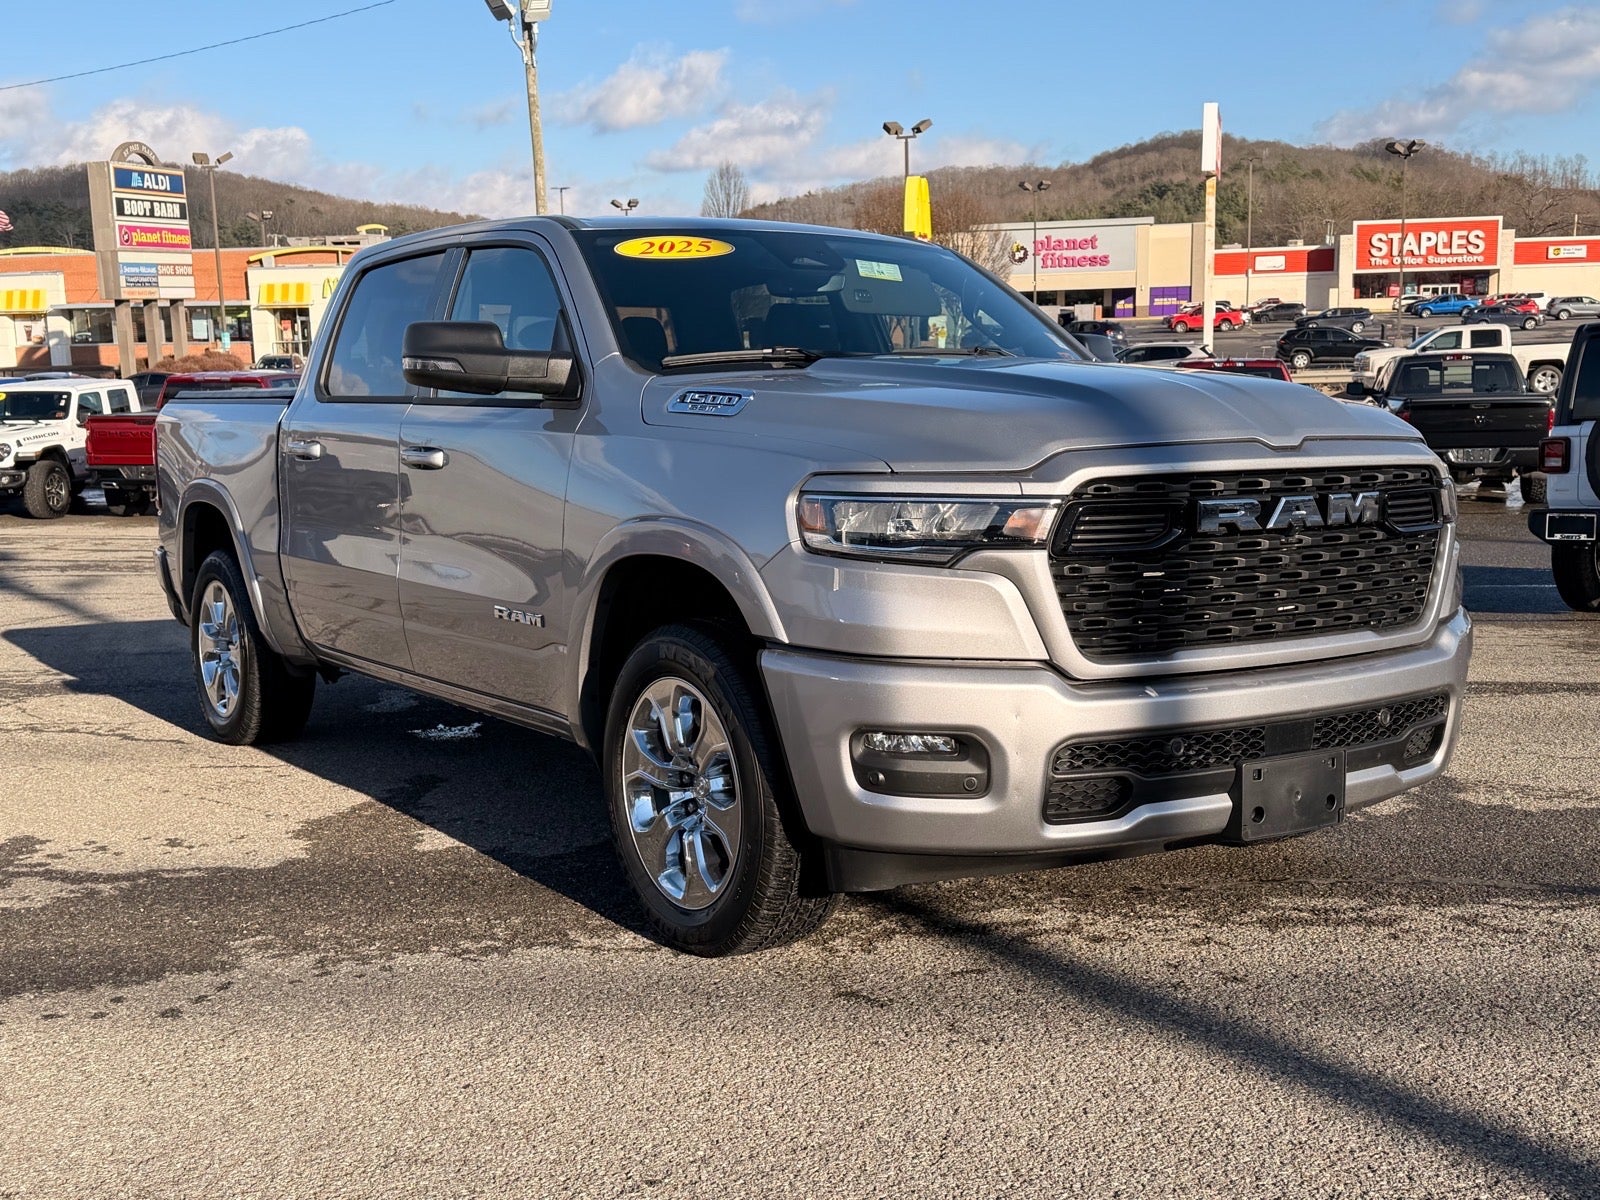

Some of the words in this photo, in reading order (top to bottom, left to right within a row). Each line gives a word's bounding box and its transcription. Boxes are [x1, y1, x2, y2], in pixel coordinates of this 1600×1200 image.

[144, 173, 170, 191] ALDI
[123, 199, 150, 216] BOOT
[153, 201, 181, 218] BARN
[131, 227, 161, 245] planet
[162, 227, 190, 245] fitness
[1033, 234, 1098, 255] planet
[1369, 230, 1486, 257] STAPLES
[639, 239, 712, 255] 2025
[1041, 252, 1110, 269] fitness
[1370, 257, 1389, 266] The
[1392, 256, 1424, 265] Ofice
[1427, 254, 1485, 265] Superstore
[158, 265, 175, 275] SHOE
[175, 265, 193, 275] SHOW
[684, 392, 740, 405] 1500
[22, 431, 59, 442] RUBICON
[1197, 490, 1381, 534] RAM
[494, 605, 545, 628] RAM
